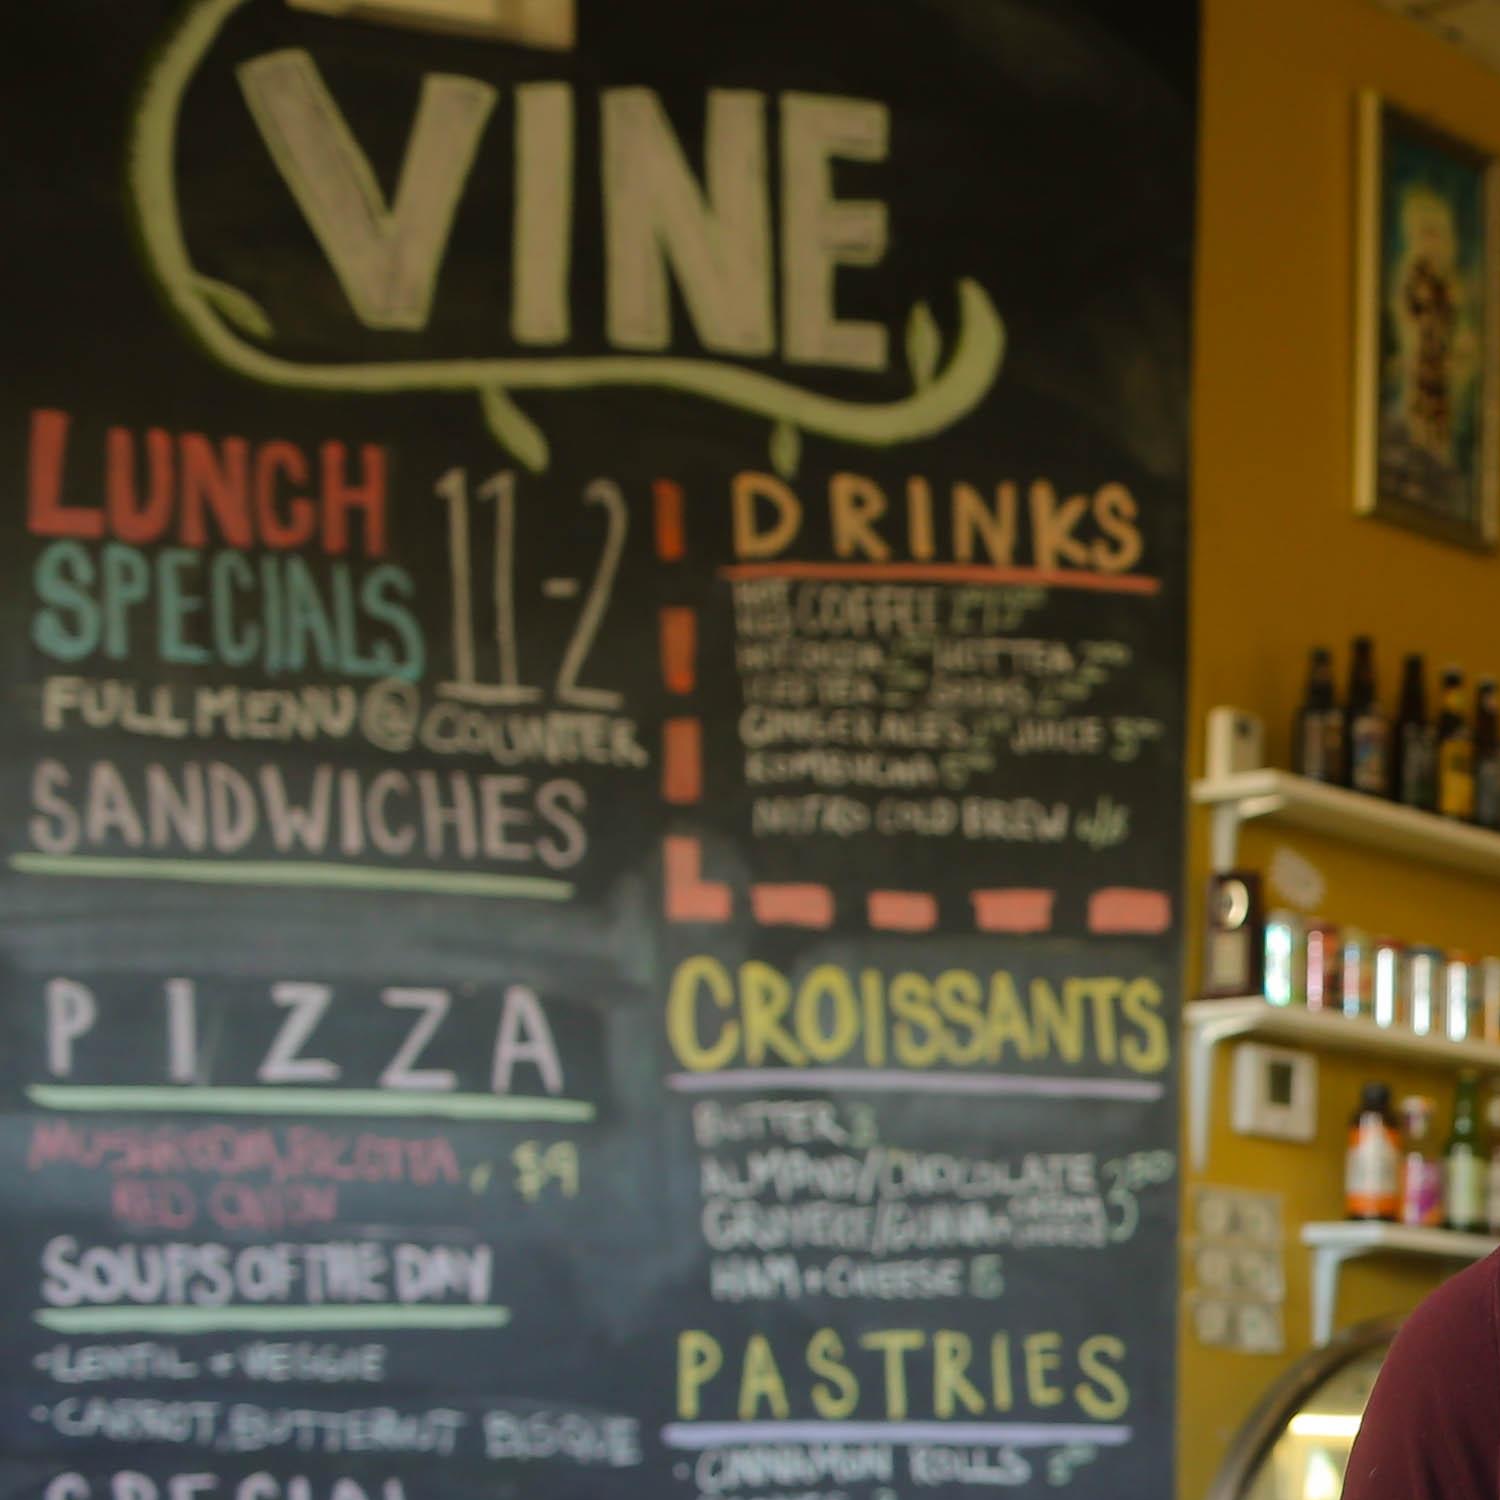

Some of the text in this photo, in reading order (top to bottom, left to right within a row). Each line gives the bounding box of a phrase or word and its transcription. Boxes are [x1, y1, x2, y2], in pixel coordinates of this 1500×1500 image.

[236, 48, 889, 372] VINE
[27, 408, 388, 556] LUNCH
[731, 471, 1144, 572] DRINKS
[32, 541, 425, 683] SPECIALS
[43, 675, 190, 738] FULL
[195, 684, 356, 743] MENU
[29, 761, 589, 865] SANDWICHES
[46, 980, 566, 1093] PIZZA
[666, 956, 1172, 1073] CROISSANTS
[39, 1234, 235, 1308] SOUPS
[677, 1331, 1131, 1423] PASTRIES
